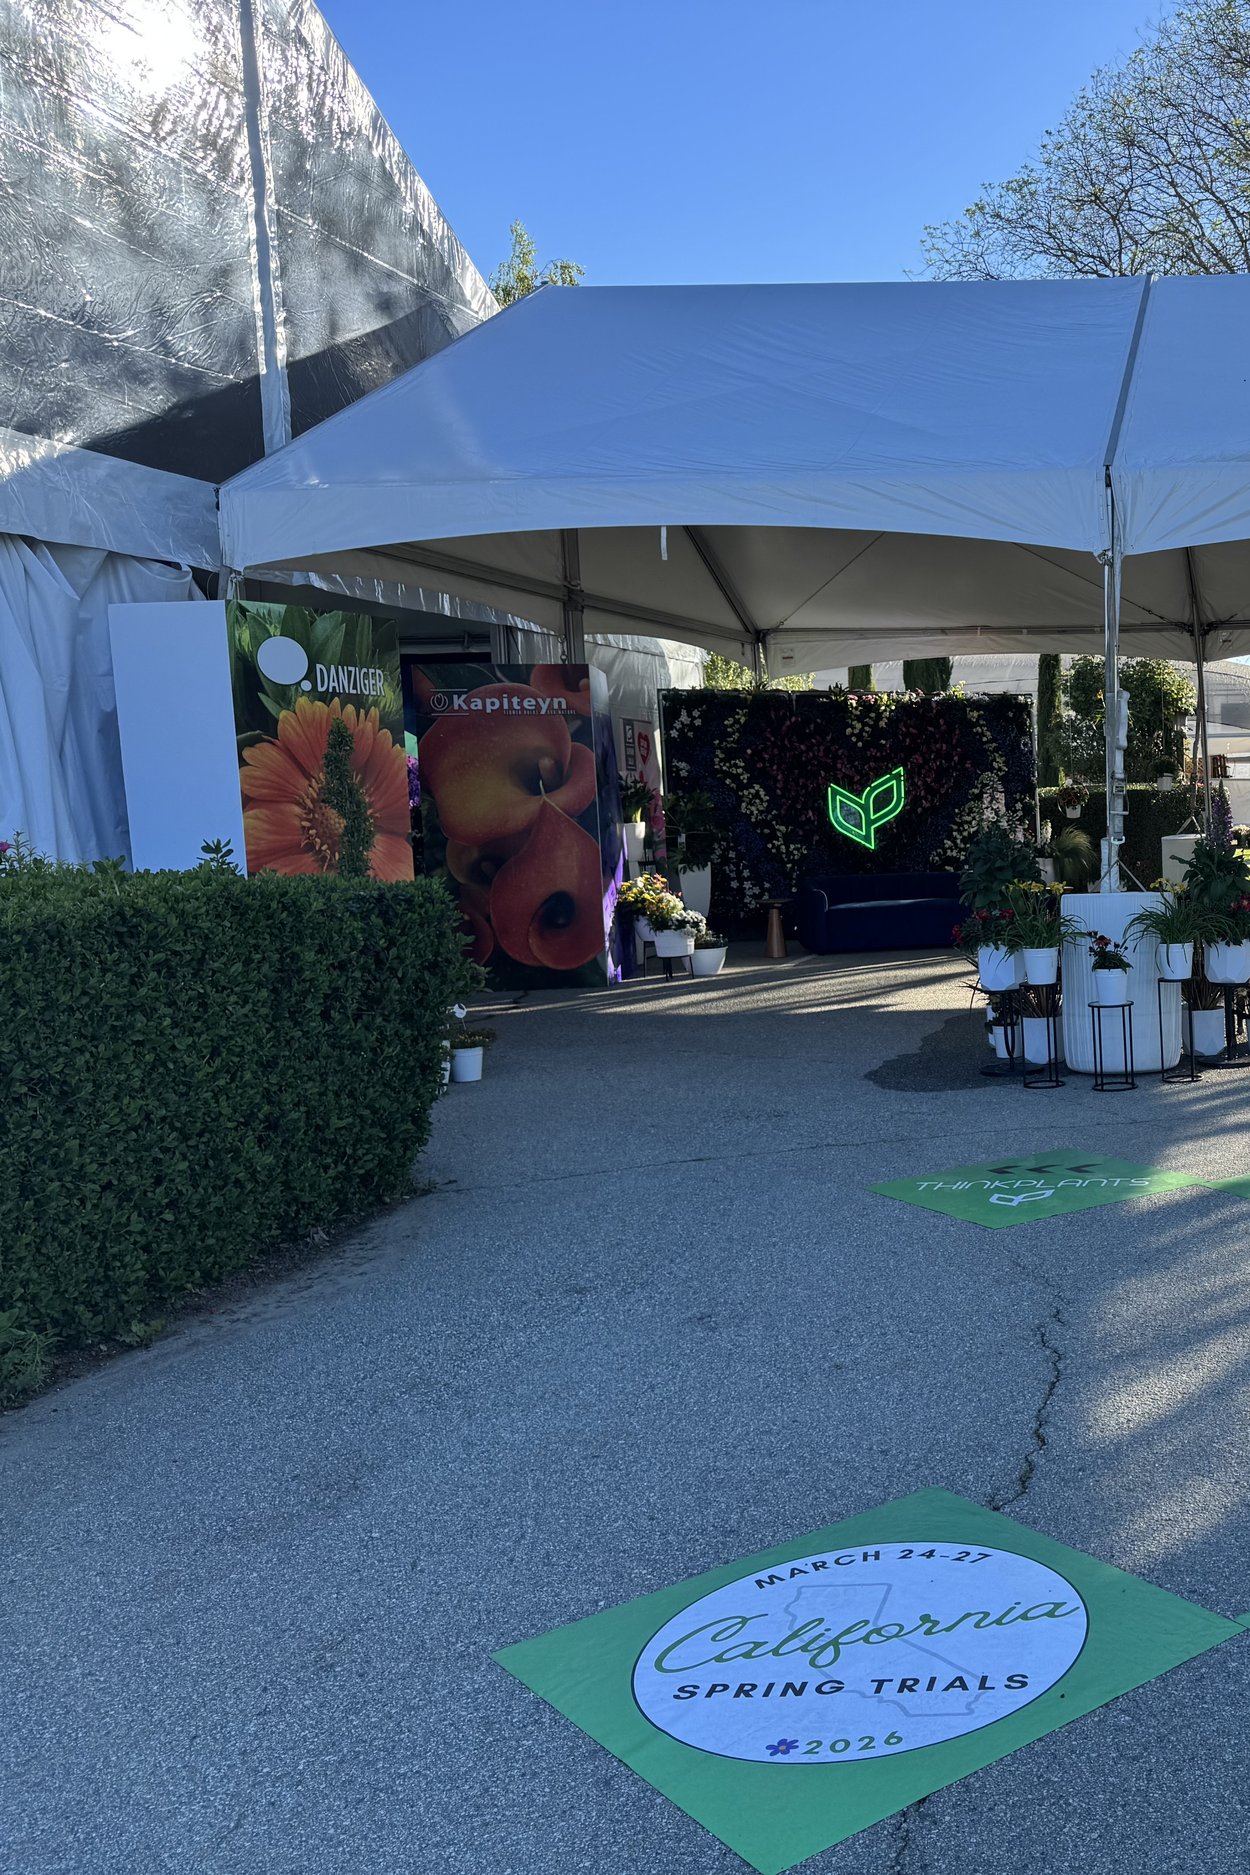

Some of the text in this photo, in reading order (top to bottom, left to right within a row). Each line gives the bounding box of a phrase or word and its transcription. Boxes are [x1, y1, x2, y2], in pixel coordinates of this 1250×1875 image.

[315, 663, 385, 696] DANZIGER
[452, 694, 567, 715] Kapiteyn
[916, 1177, 1152, 1191] THINKPLANTS
[755, 1549, 993, 1590] MARCH 24-27
[654, 1601, 1082, 1673] California
[672, 1673, 1030, 1700] SPRING TRIALS
[801, 1731, 904, 1756] 2026
